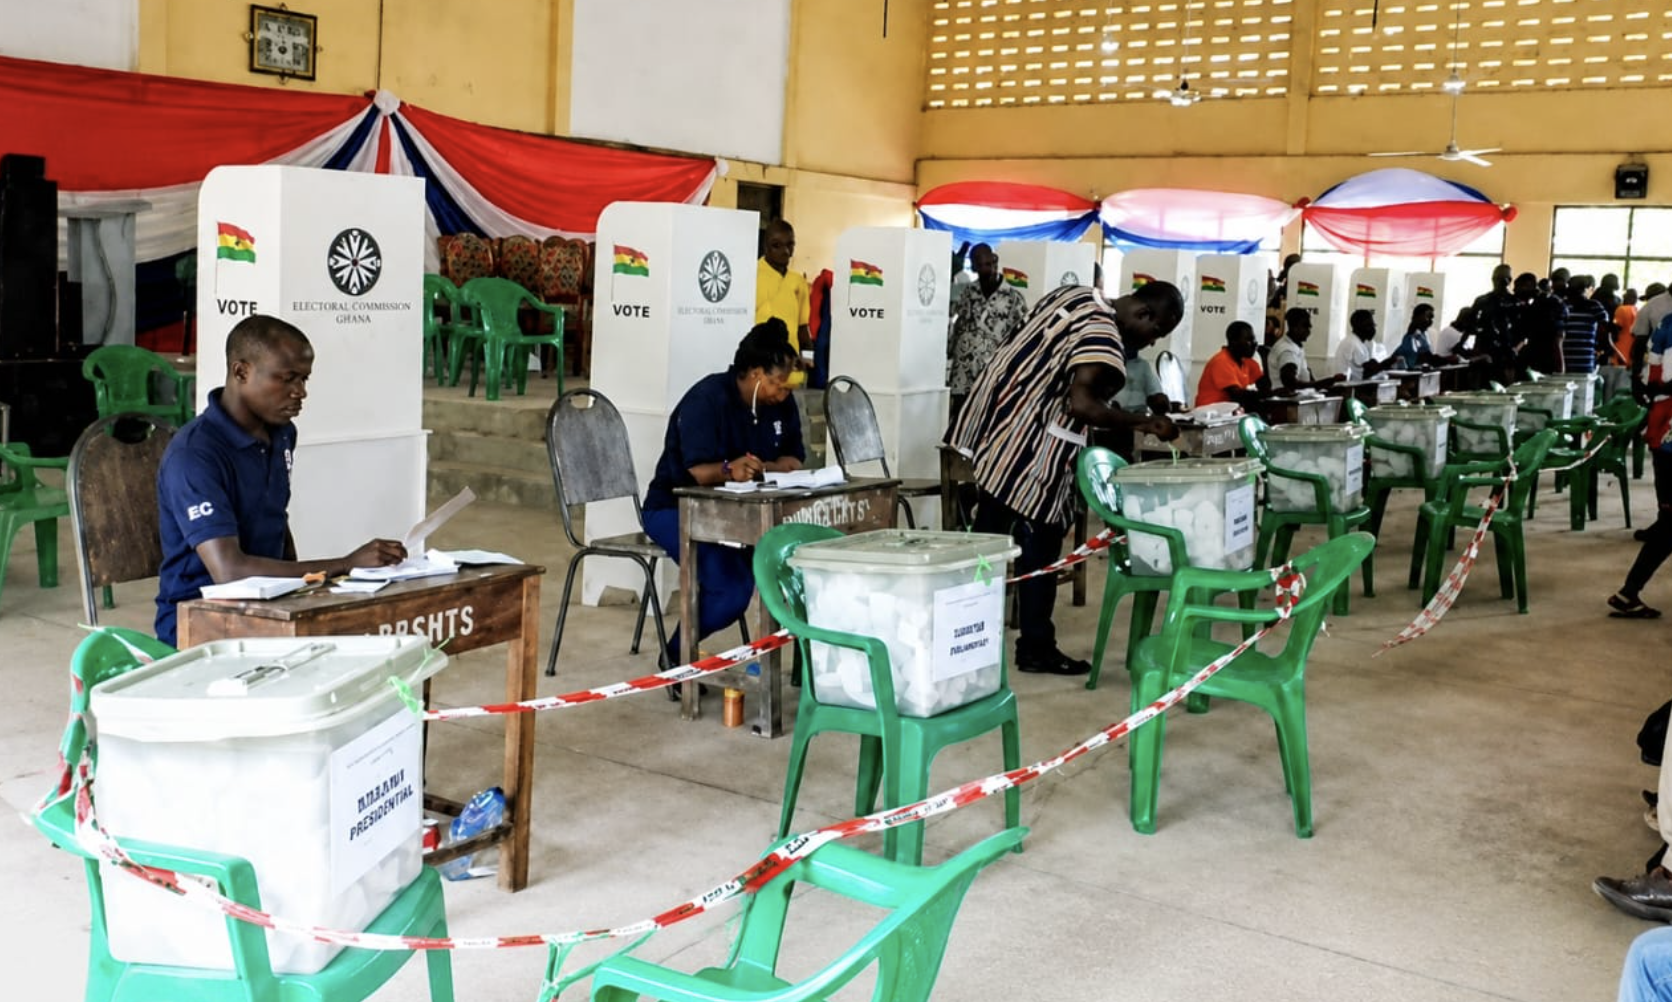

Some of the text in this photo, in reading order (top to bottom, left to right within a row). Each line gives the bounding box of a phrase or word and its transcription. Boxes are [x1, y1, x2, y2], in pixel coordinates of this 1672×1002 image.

[217, 299, 258, 316] VOTE
[293, 301, 411, 311] ELECTORAL COMMISSION
[613, 304, 650, 318] VOTE
[1200, 305, 1226, 314] VOTE
[335, 314, 372, 324] GHANA
[850, 308, 884, 318] VOTE
[187, 502, 214, 521] EC
[350, 784, 414, 841] PRESIDENTIAL
